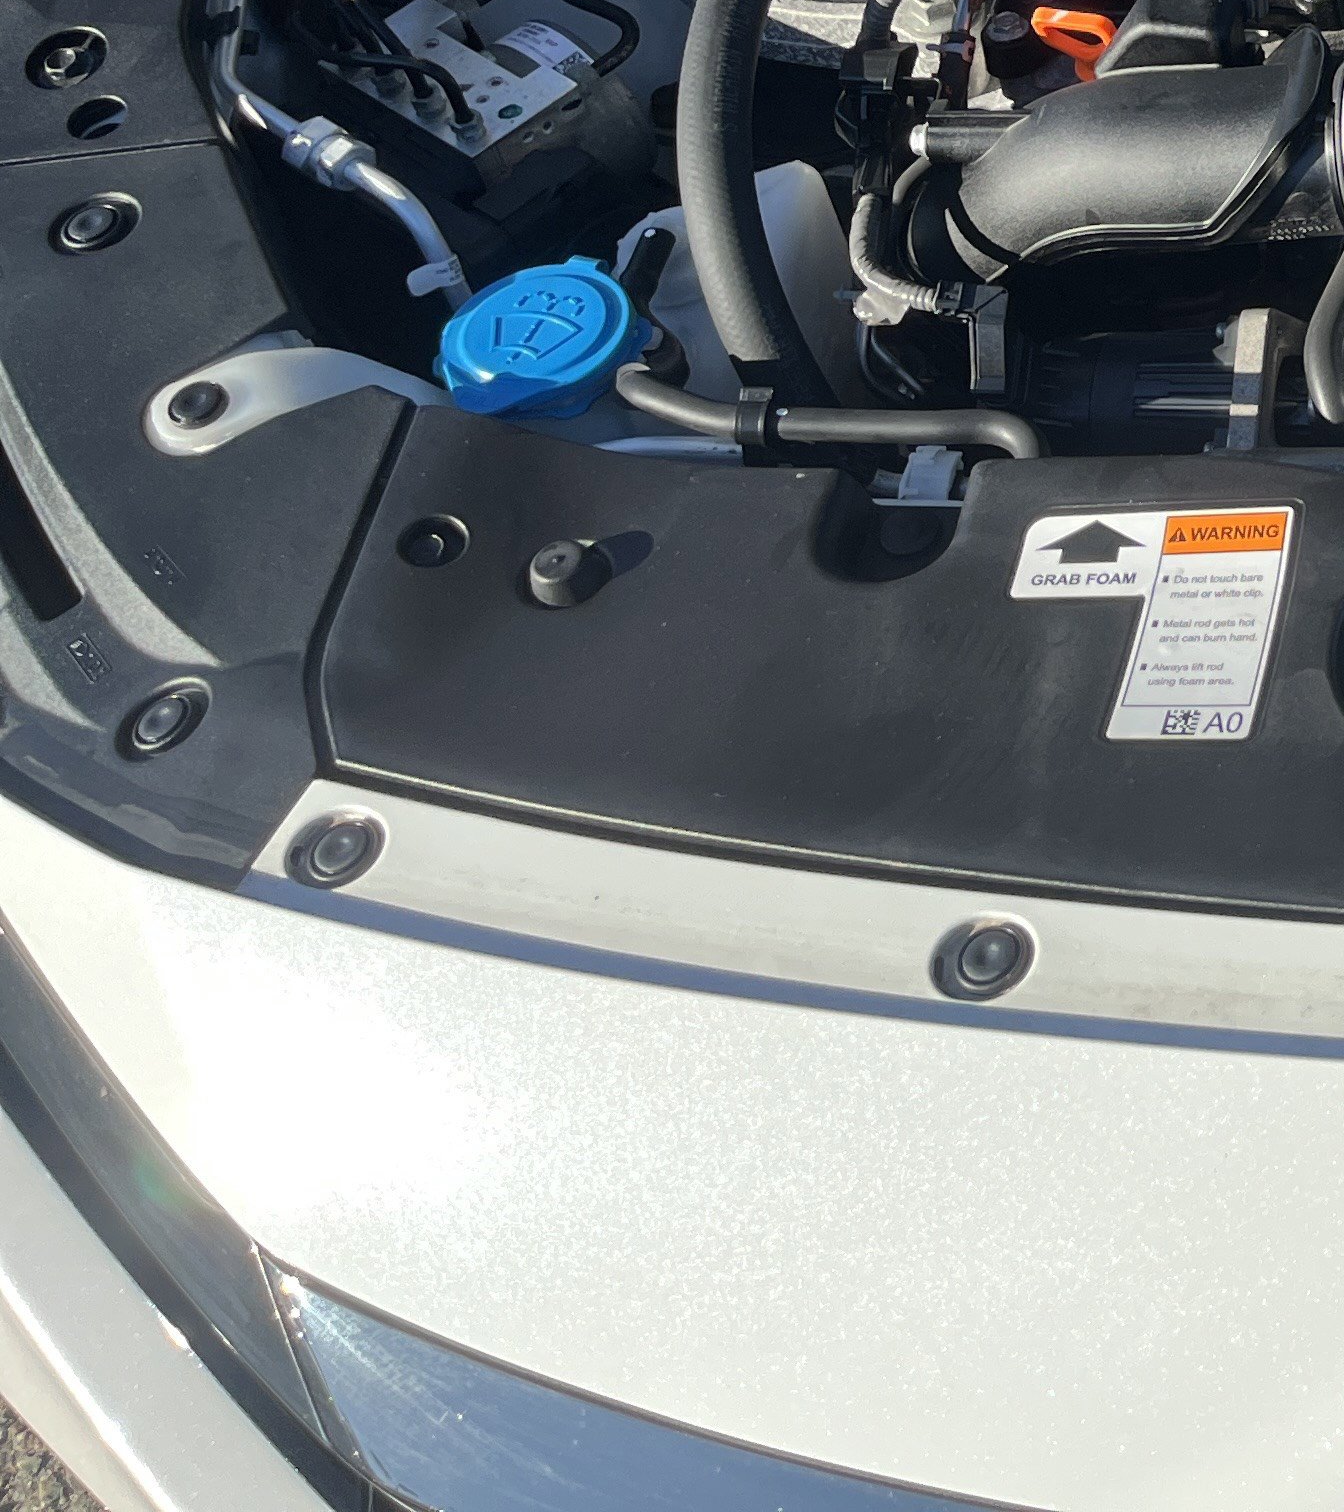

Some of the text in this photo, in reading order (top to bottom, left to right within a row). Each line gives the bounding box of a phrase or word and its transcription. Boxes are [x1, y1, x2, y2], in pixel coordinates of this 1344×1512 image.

[1190, 524, 1280, 541] WARNING
[1031, 572, 1137, 586] GRAB FOAM
[1174, 574, 1264, 584] Do not touch bare
[1170, 590, 1199, 599] metal
[1214, 589, 1241, 598] white
[1163, 618, 1256, 629] Metal rod gets hot
[1159, 634, 1180, 643] and
[1203, 634, 1227, 642] burn
[1151, 663, 1224, 673] Always lift rod
[1147, 678, 1177, 687] using
[1179, 677, 1206, 686] foam
[1202, 711, 1243, 734] A0
